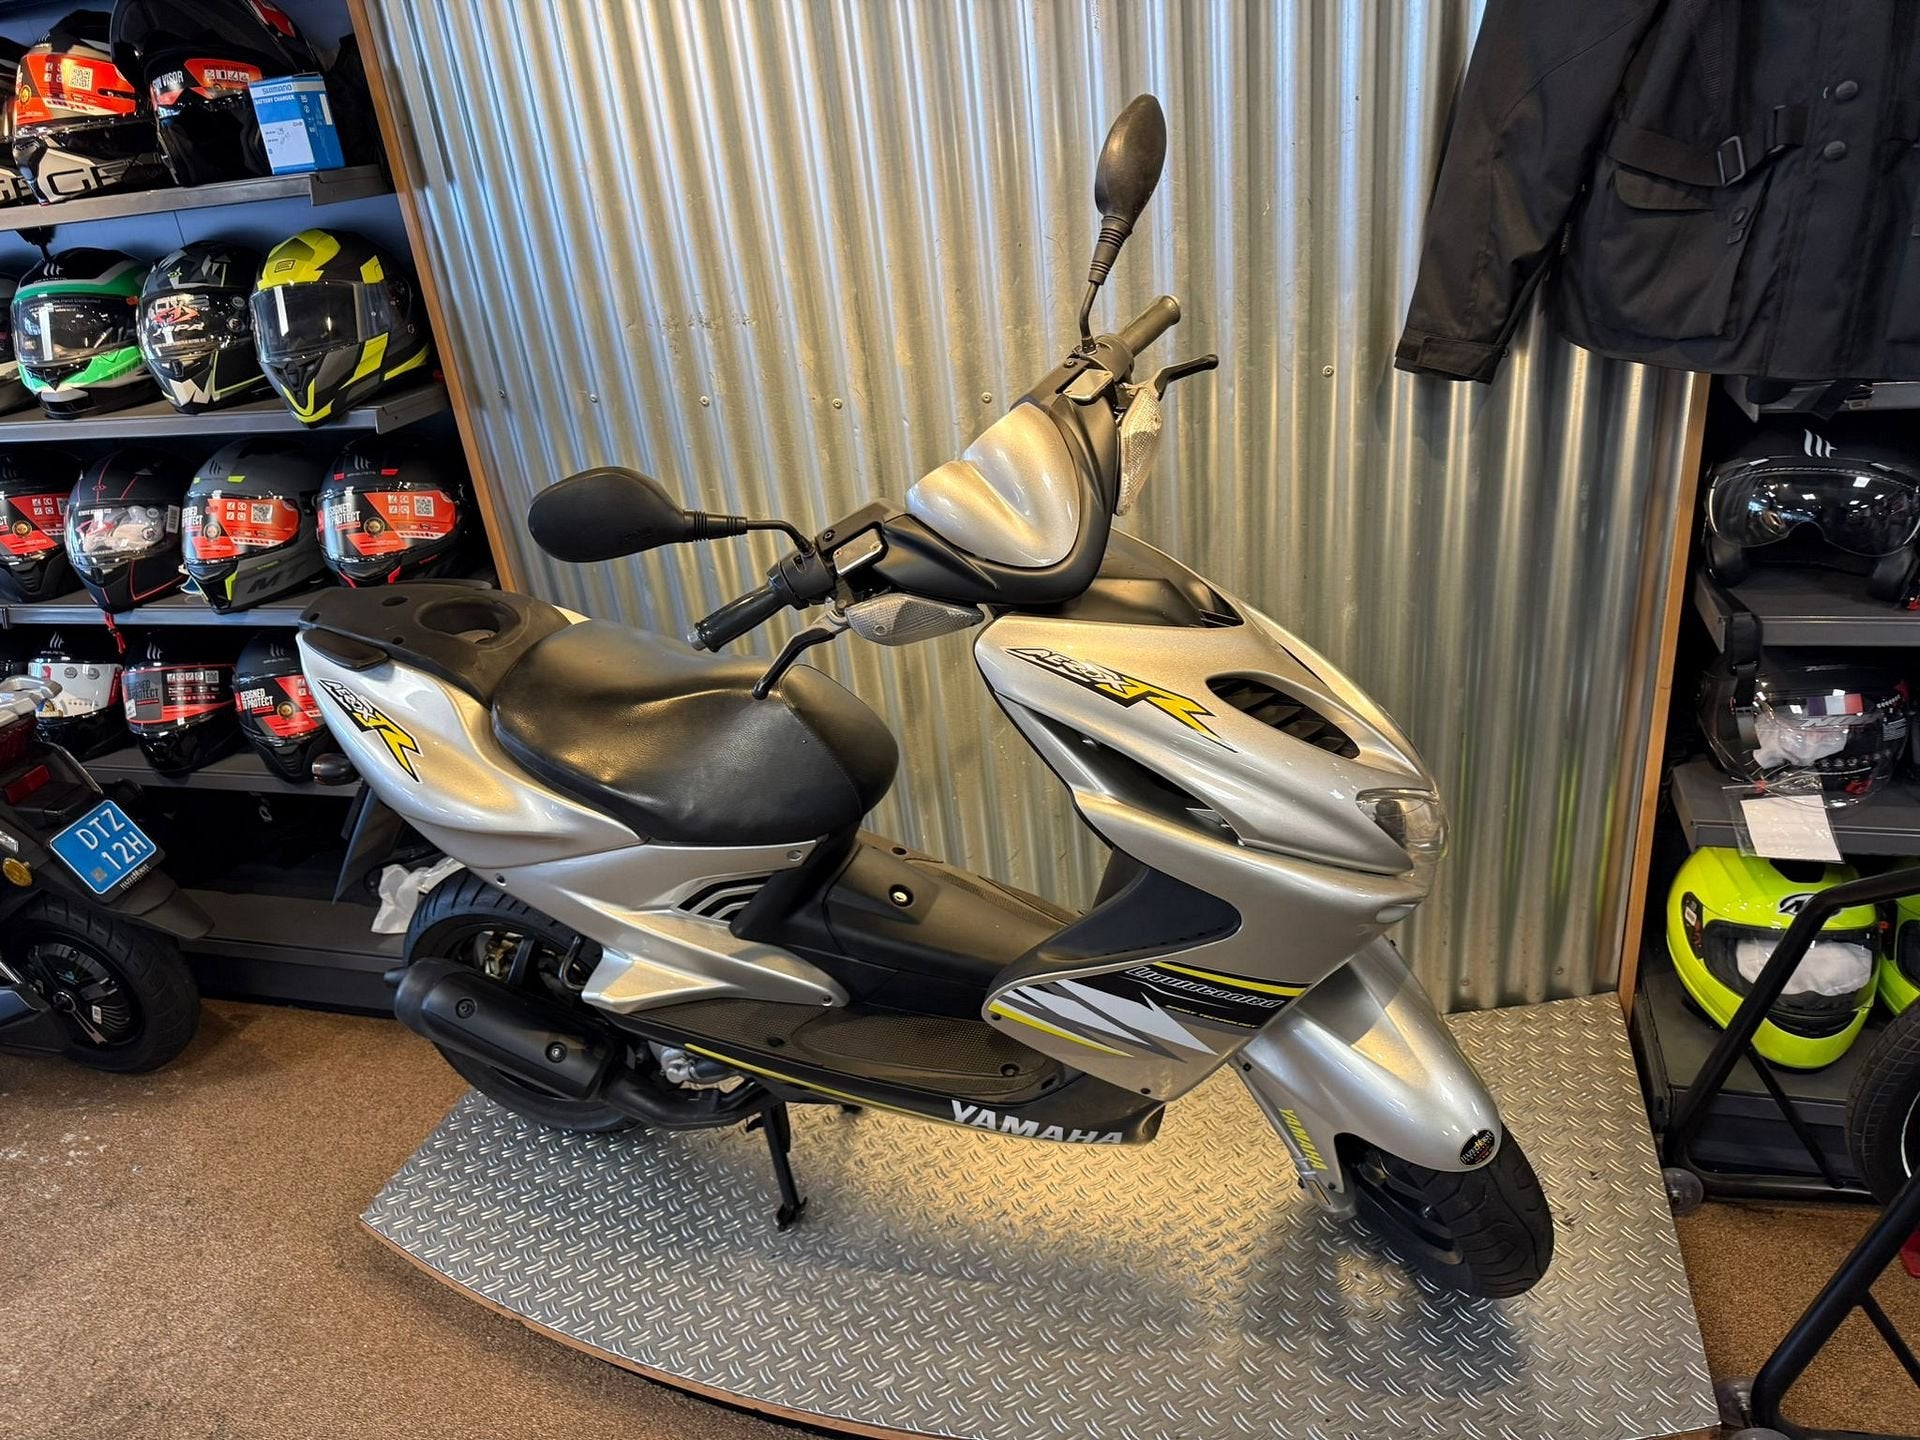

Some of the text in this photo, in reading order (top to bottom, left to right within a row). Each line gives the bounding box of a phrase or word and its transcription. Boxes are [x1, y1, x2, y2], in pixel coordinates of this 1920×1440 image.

[162, 70, 184, 87] VISOR
[247, 696, 274, 709] PROTECT
[75, 808, 126, 850] DTZ
[101, 831, 148, 870] 12H
[951, 1099, 1124, 1145] YAMAHA
[1279, 1107, 1329, 1170] YAMAHA
